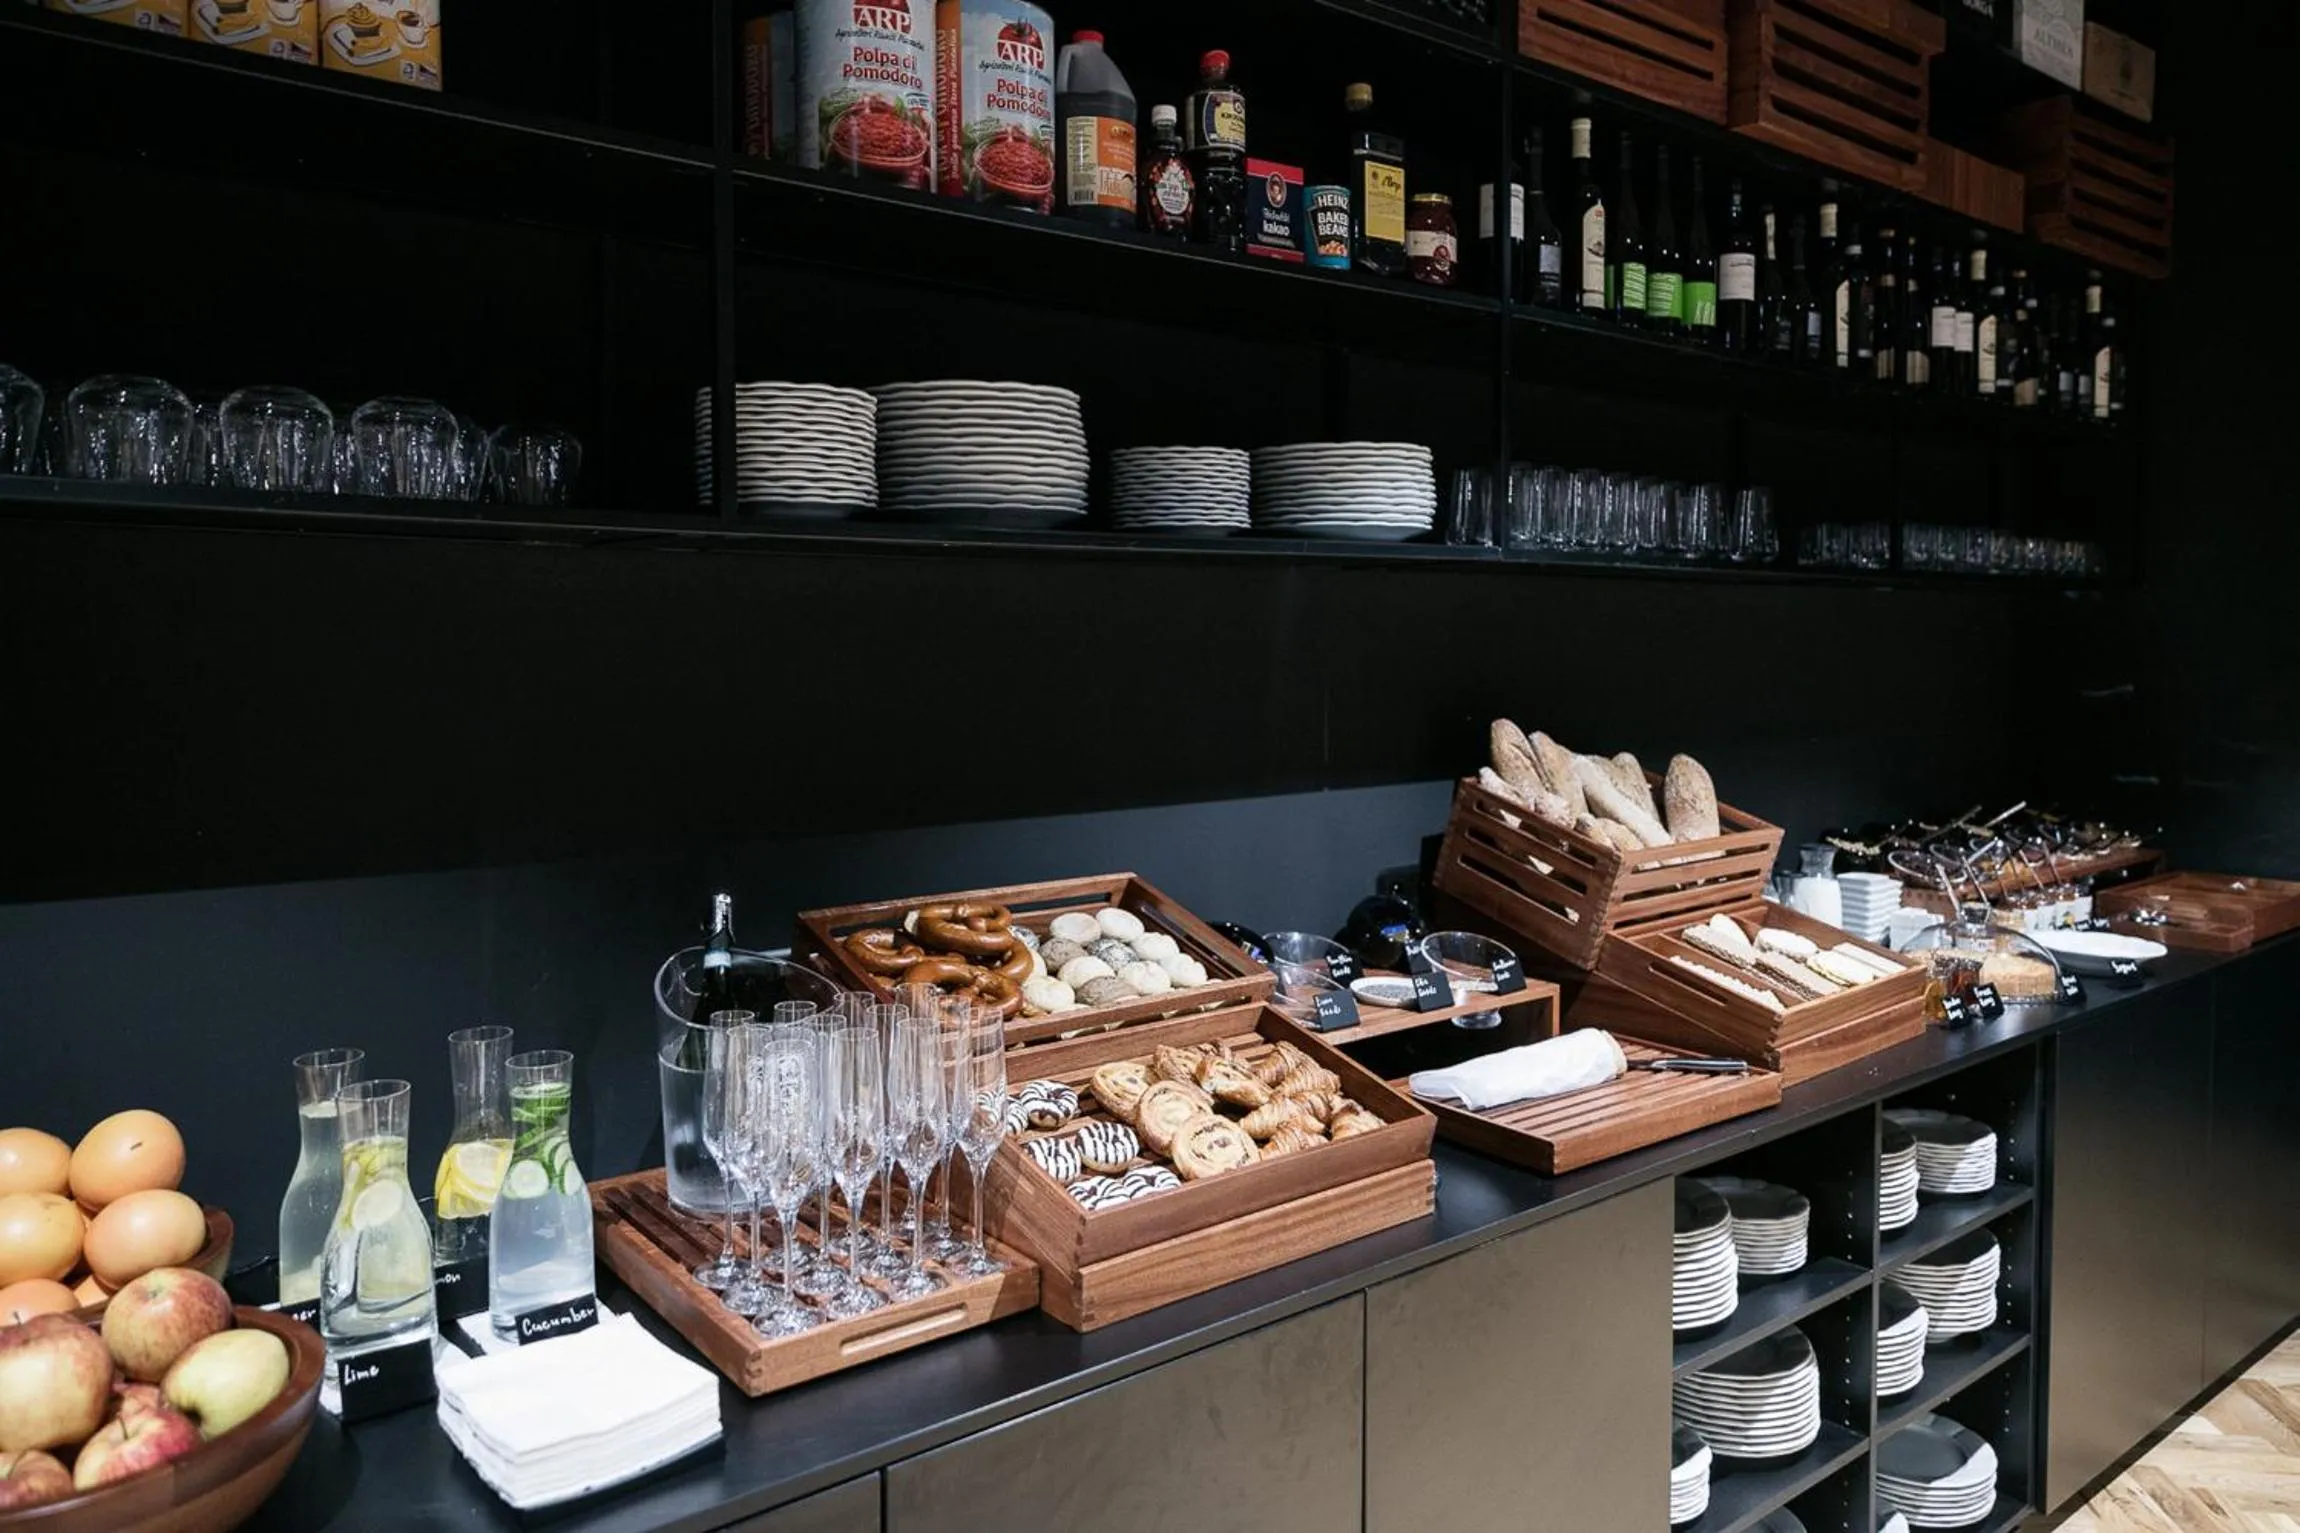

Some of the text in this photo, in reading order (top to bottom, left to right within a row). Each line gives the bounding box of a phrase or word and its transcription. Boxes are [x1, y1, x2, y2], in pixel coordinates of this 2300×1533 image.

[856, 7, 912, 35] ARP
[853, 47, 899, 67] Polpa
[999, 42, 1044, 70] ARP
[843, 64, 923, 90] Pomodoro
[997, 79, 1036, 99] Polpa
[1317, 194, 1348, 210] HEINZ
[1317, 211, 1350, 226] BAKED
[522, 1306, 595, 1337] Cucumber
[344, 1364, 380, 1386] Lime
